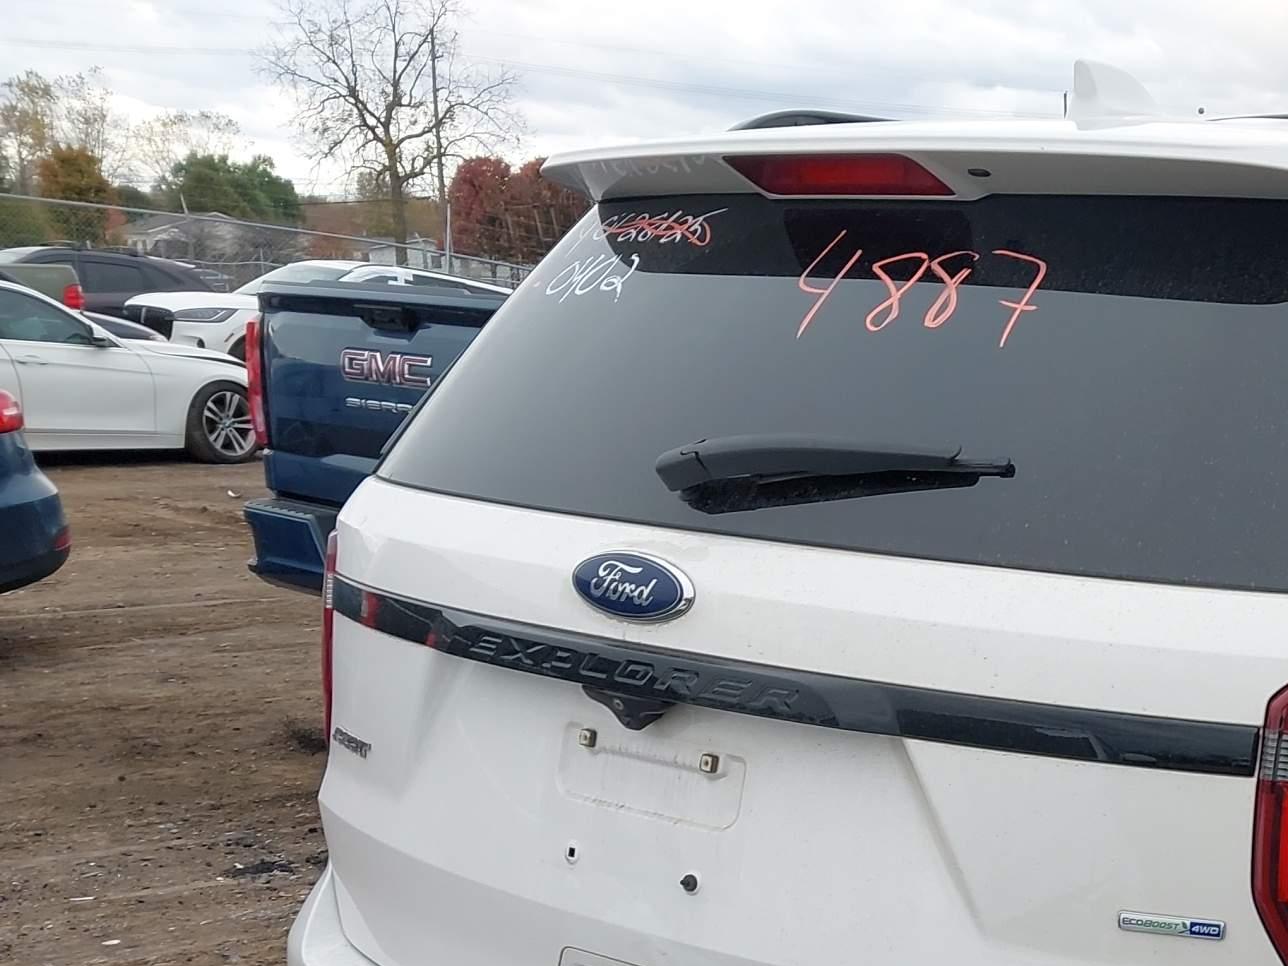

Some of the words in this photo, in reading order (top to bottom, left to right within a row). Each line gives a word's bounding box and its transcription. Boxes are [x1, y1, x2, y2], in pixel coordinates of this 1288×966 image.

[796, 229, 1048, 349] 4887
[340, 347, 433, 389] GMC
[344, 397, 414, 413] SIERR
[589, 559, 659, 607] Ford
[468, 634, 801, 714] EXPLORER
[1121, 916, 1181, 931] ECOBOOST
[1190, 924, 1221, 936] 4WD
